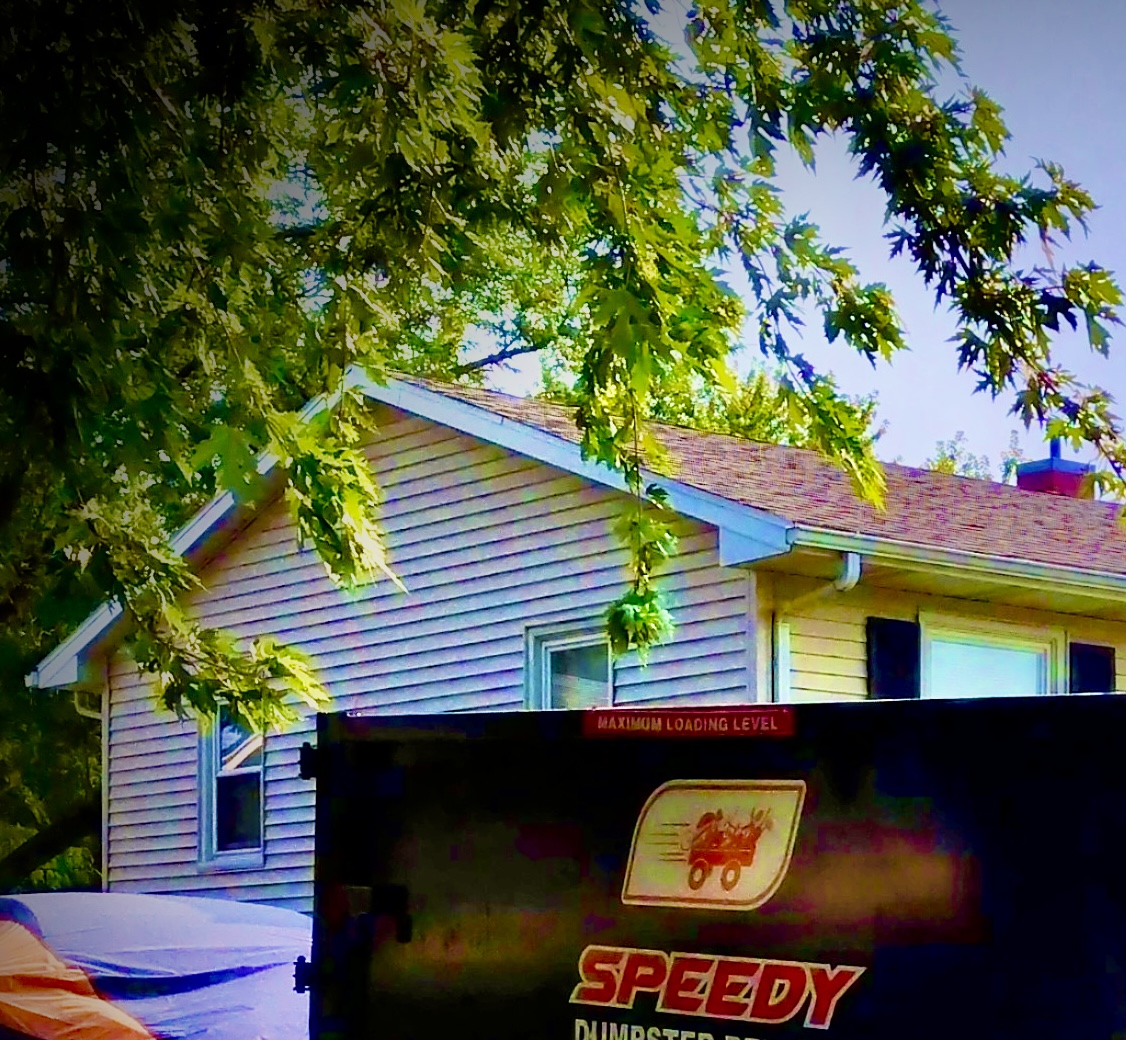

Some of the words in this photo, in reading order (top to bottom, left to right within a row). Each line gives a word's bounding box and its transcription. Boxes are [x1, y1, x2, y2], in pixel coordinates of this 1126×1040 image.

[666, 717, 728, 731] LOADING
[733, 716, 778, 731] LEVEL
[569, 945, 867, 1029] SPEEDY
